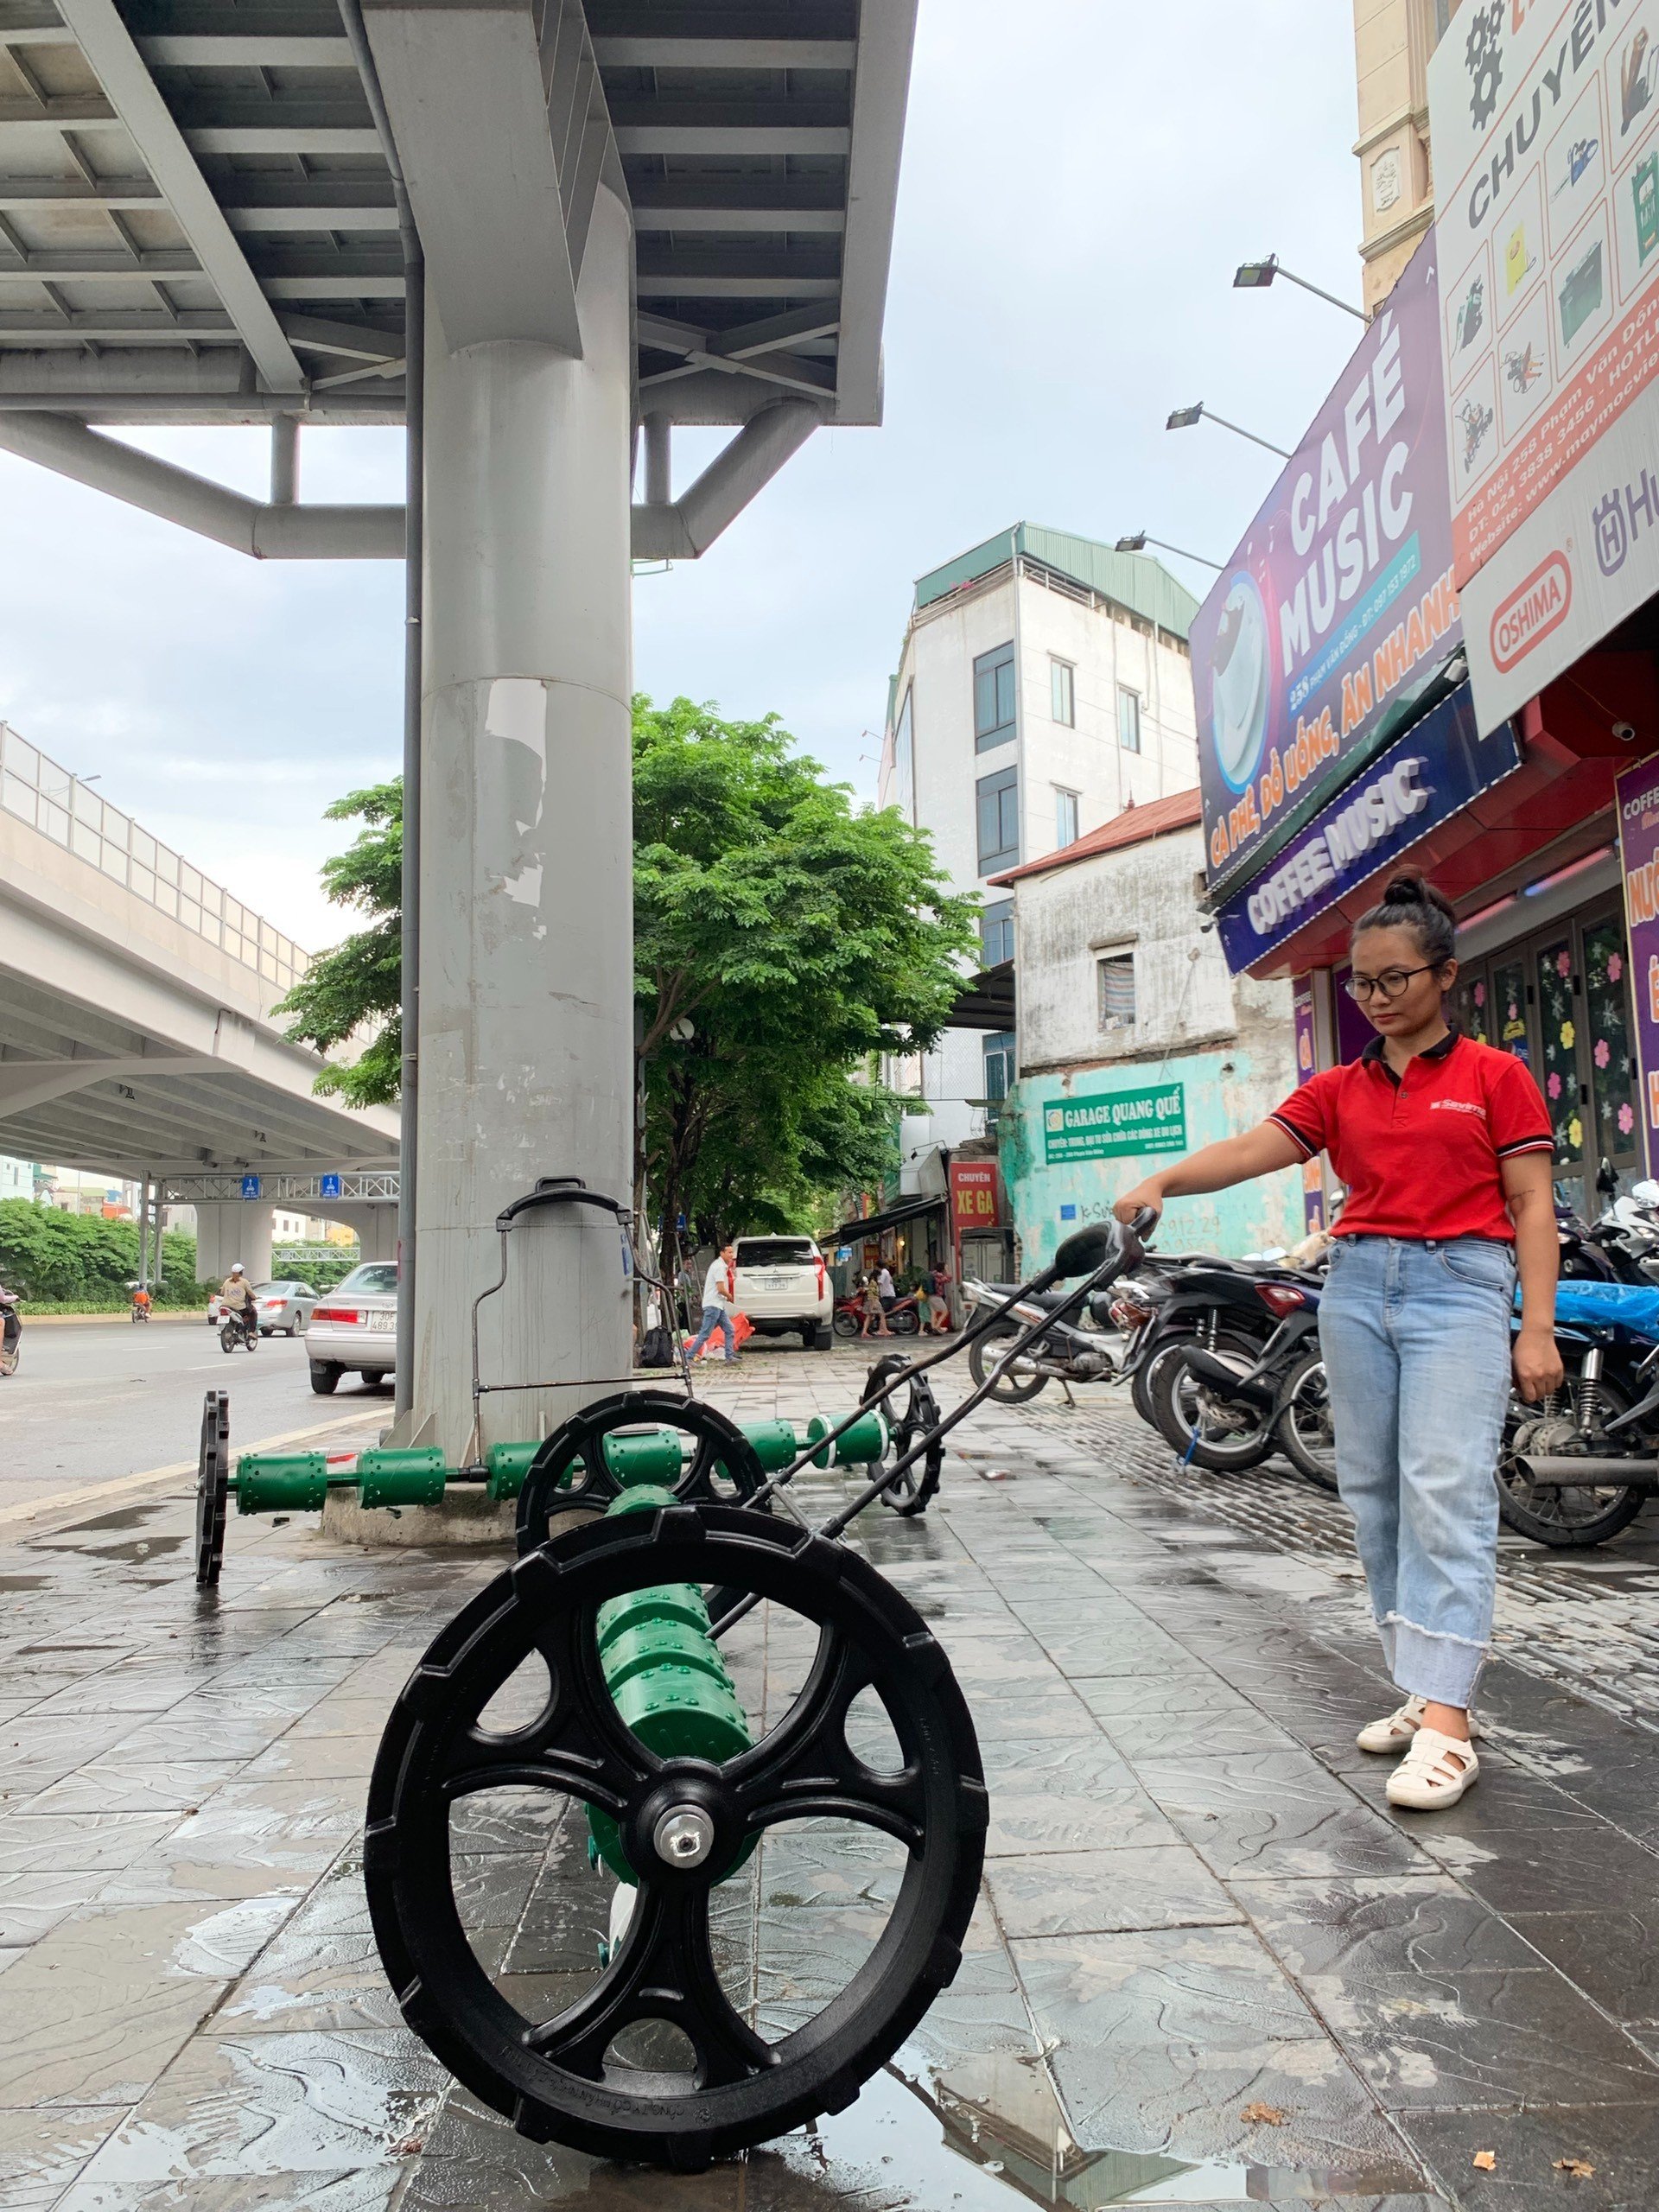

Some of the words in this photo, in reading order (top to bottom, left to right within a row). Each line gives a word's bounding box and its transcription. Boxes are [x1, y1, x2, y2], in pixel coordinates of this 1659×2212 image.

[1292, 308, 1406, 556] CAFÉ
[1468, 498, 1484, 523] Hà
[1487, 469, 1509, 501] Nội
[1512, 437, 1537, 474] 258
[1541, 387, 1582, 441] Phạm
[1586, 346, 1618, 385] Văn
[1623, 295, 1659, 345] Đồn
[1470, 501, 1522, 563] Website:
[1526, 348, 1659, 502] www.maymocvie
[1491, 484, 1516, 518] 024
[1518, 442, 1553, 488] 3838
[1557, 395, 1594, 445] 3456
[1280, 442, 1414, 678] MUSIC
[1290, 676, 1309, 710] 258
[1400, 554, 1416, 582] 1972
[1499, 575, 1562, 653] OSHIMA
[1341, 662, 1374, 738] ĂN
[1372, 563, 1461, 703] NHANH
[1248, 836, 1336, 935] COFFEE
[1323, 757, 1430, 871] MUSIC
[957, 1171, 991, 1182] CHUYÊN
[1065, 1105, 1111, 1128] GARAGE
[1112, 1099, 1154, 1126] QUANG
[1155, 1085, 1182, 1121] QUẾ
[957, 1190, 974, 1215] XE
[976, 1190, 994, 1215] GA
